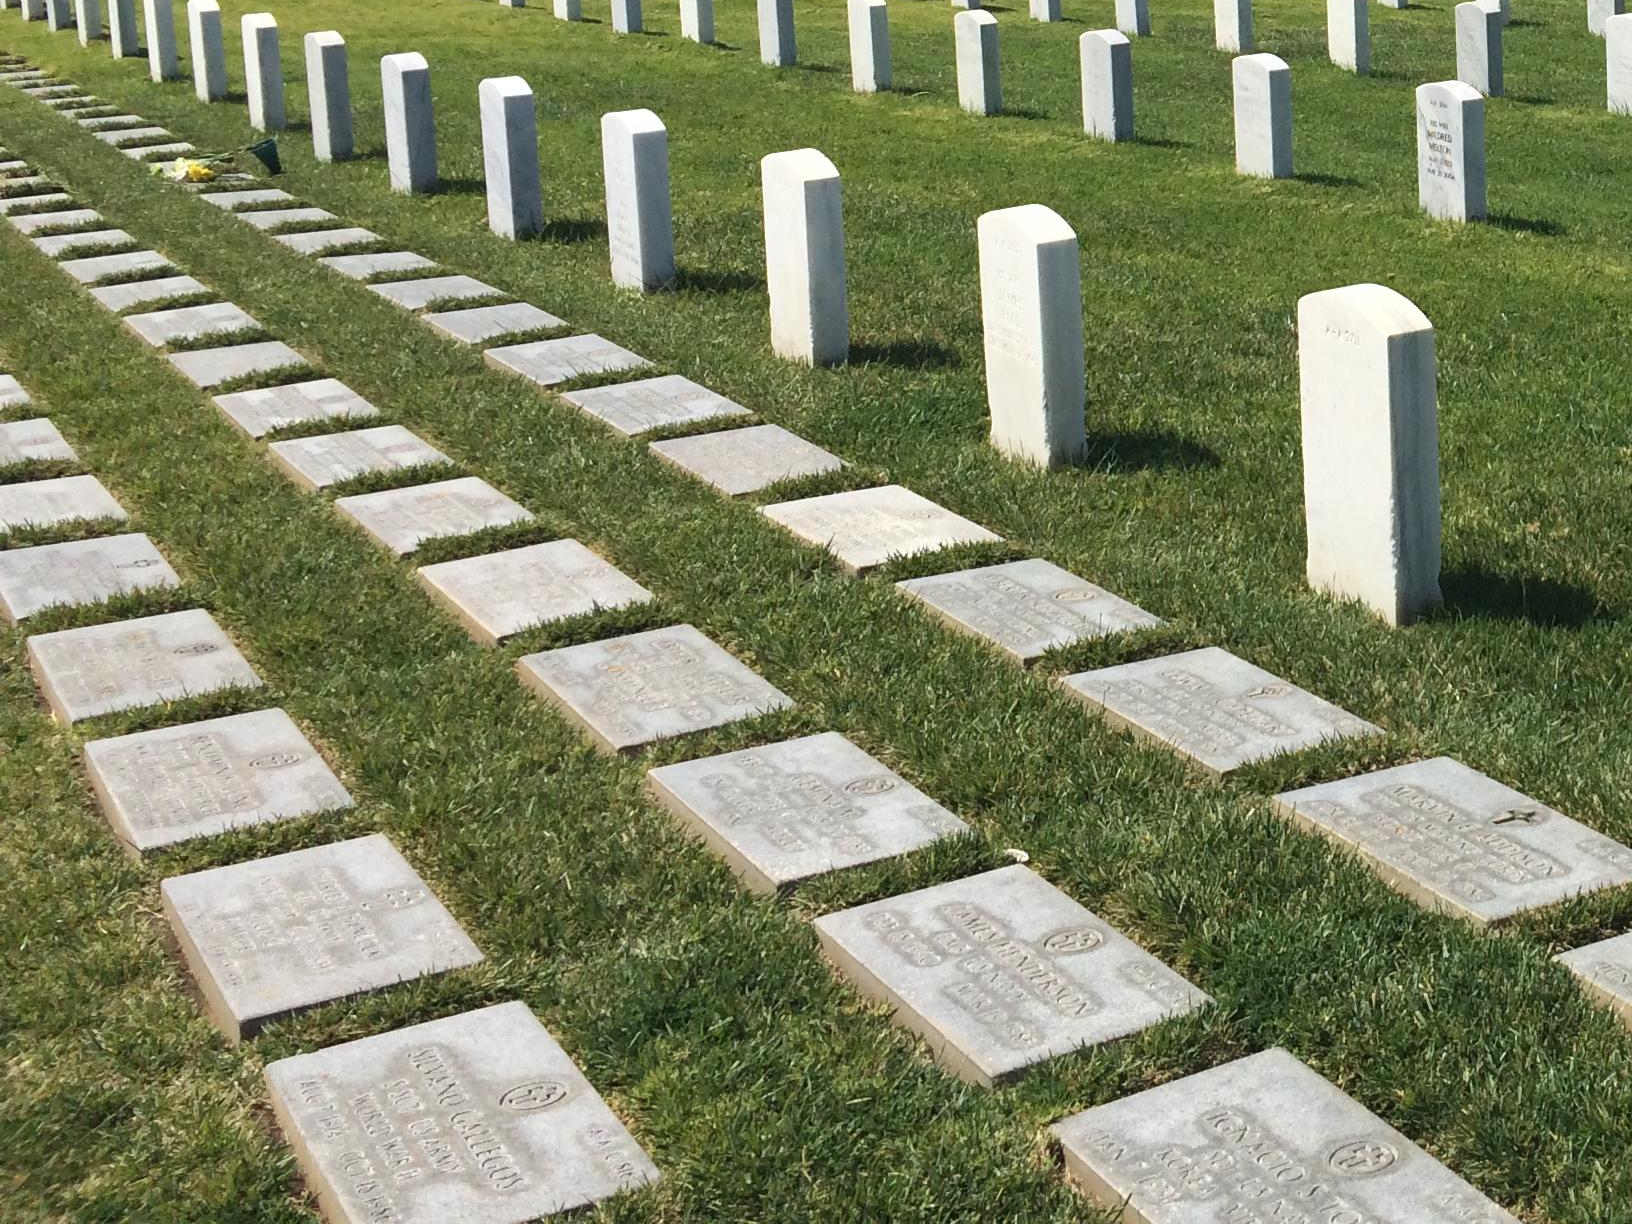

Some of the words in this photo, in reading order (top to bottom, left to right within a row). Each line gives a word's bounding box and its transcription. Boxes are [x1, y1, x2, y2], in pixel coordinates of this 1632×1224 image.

[1428, 130, 1453, 143] MILDRED
[1388, 786, 1464, 822] MARTIN
[940, 902, 1004, 942] JAMES
[989, 941, 1097, 1015] HENDERSON
[386, 1089, 425, 1115] SGT
[404, 1048, 471, 1107] SILVANO
[446, 1110, 529, 1191] GALLEGOS
[292, 1077, 331, 1105] AUG
[334, 1148, 378, 1180] OCT
[345, 1093, 395, 1138] WORLD
[374, 1137, 417, 1170] WAR
[405, 1118, 438, 1137] US
[1083, 1130, 1134, 1161] JAN
[1202, 1112, 1311, 1183] IGNACIO
[417, 1135, 464, 1177] ARMY
[1149, 1148, 1227, 1195] KOREA
[1235, 1178, 1275, 1199] US
